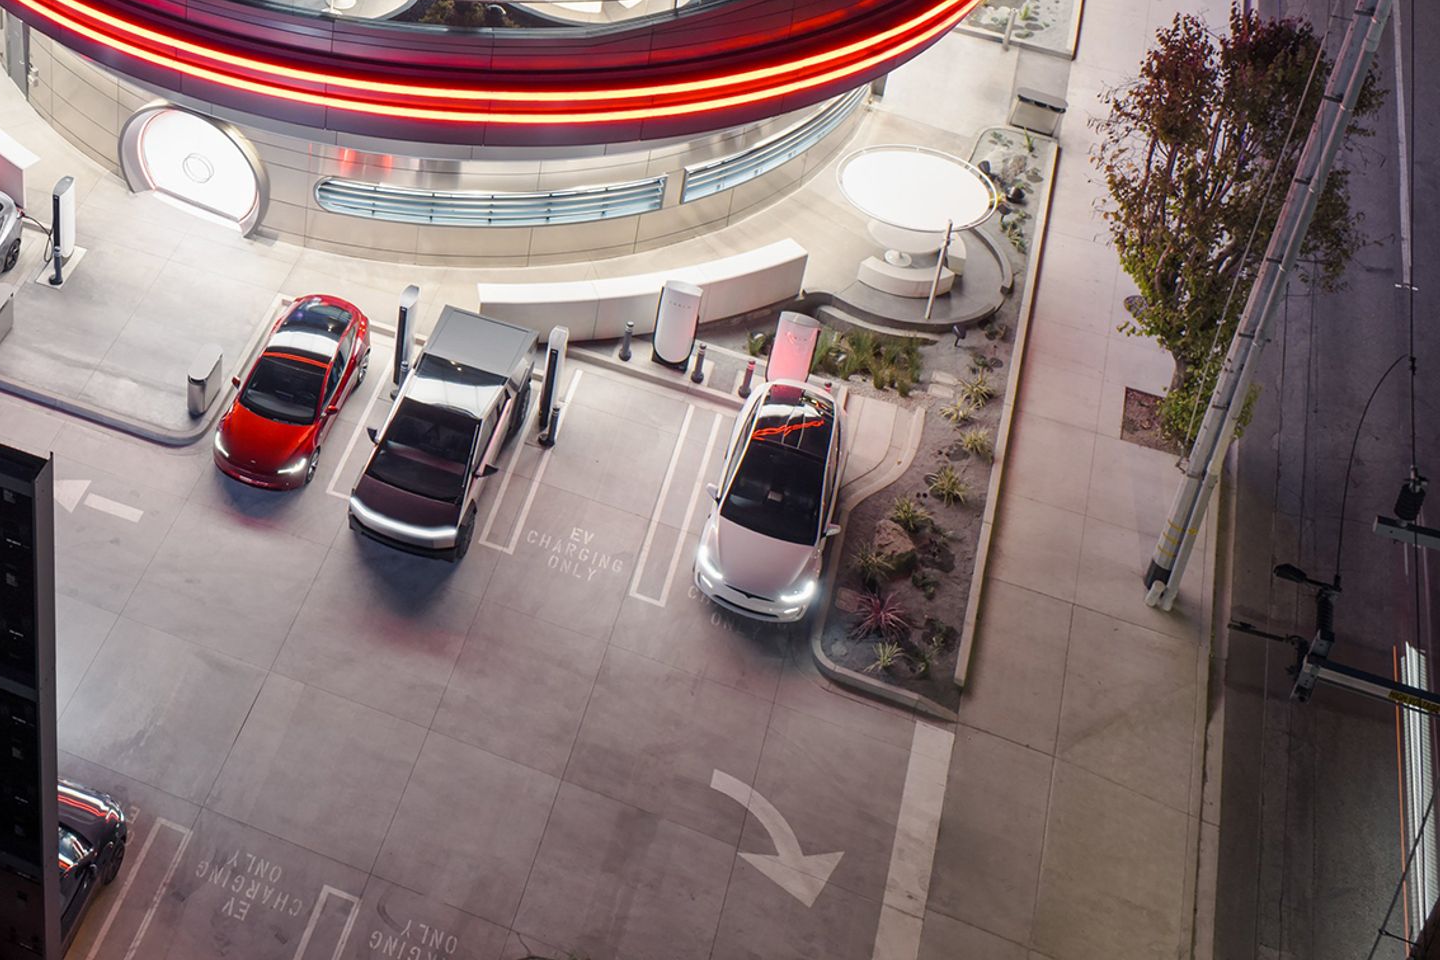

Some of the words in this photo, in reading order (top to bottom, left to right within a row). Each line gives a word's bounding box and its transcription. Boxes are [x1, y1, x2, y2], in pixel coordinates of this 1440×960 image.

[527, 530, 624, 573] CHARGING
[570, 527, 595, 545] EV
[548, 554, 597, 581] ONLY
[226, 850, 282, 883] ONLY
[196, 860, 303, 917] CHARGING
[222, 897, 250, 921] EV
[401, 920, 458, 954] ONLY
